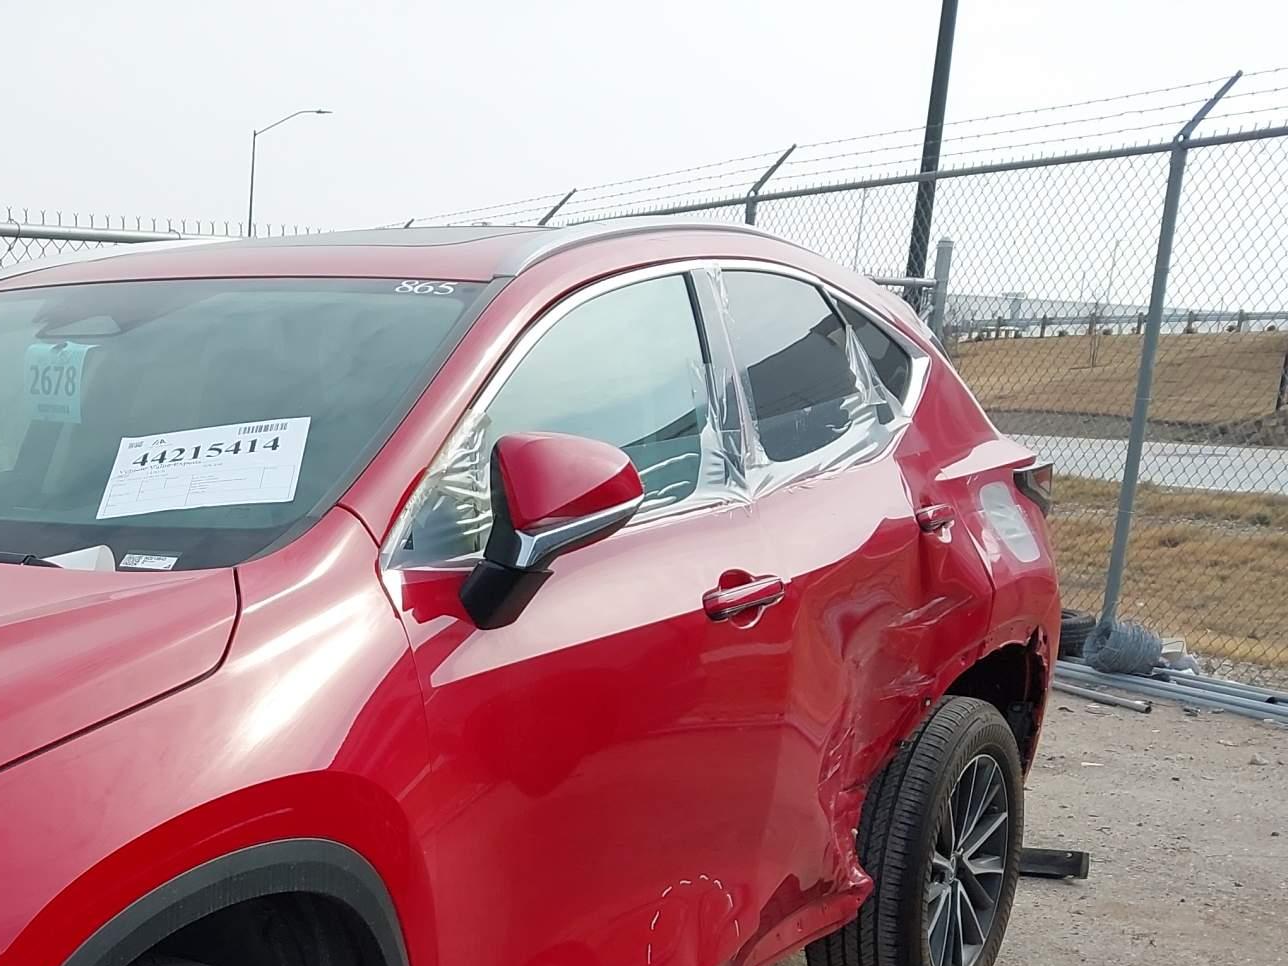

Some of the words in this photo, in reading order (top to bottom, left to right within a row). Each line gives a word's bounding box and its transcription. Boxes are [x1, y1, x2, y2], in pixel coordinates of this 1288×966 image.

[395, 280, 458, 295] 865
[29, 365, 76, 397] 2678
[132, 436, 280, 467] 44215414
